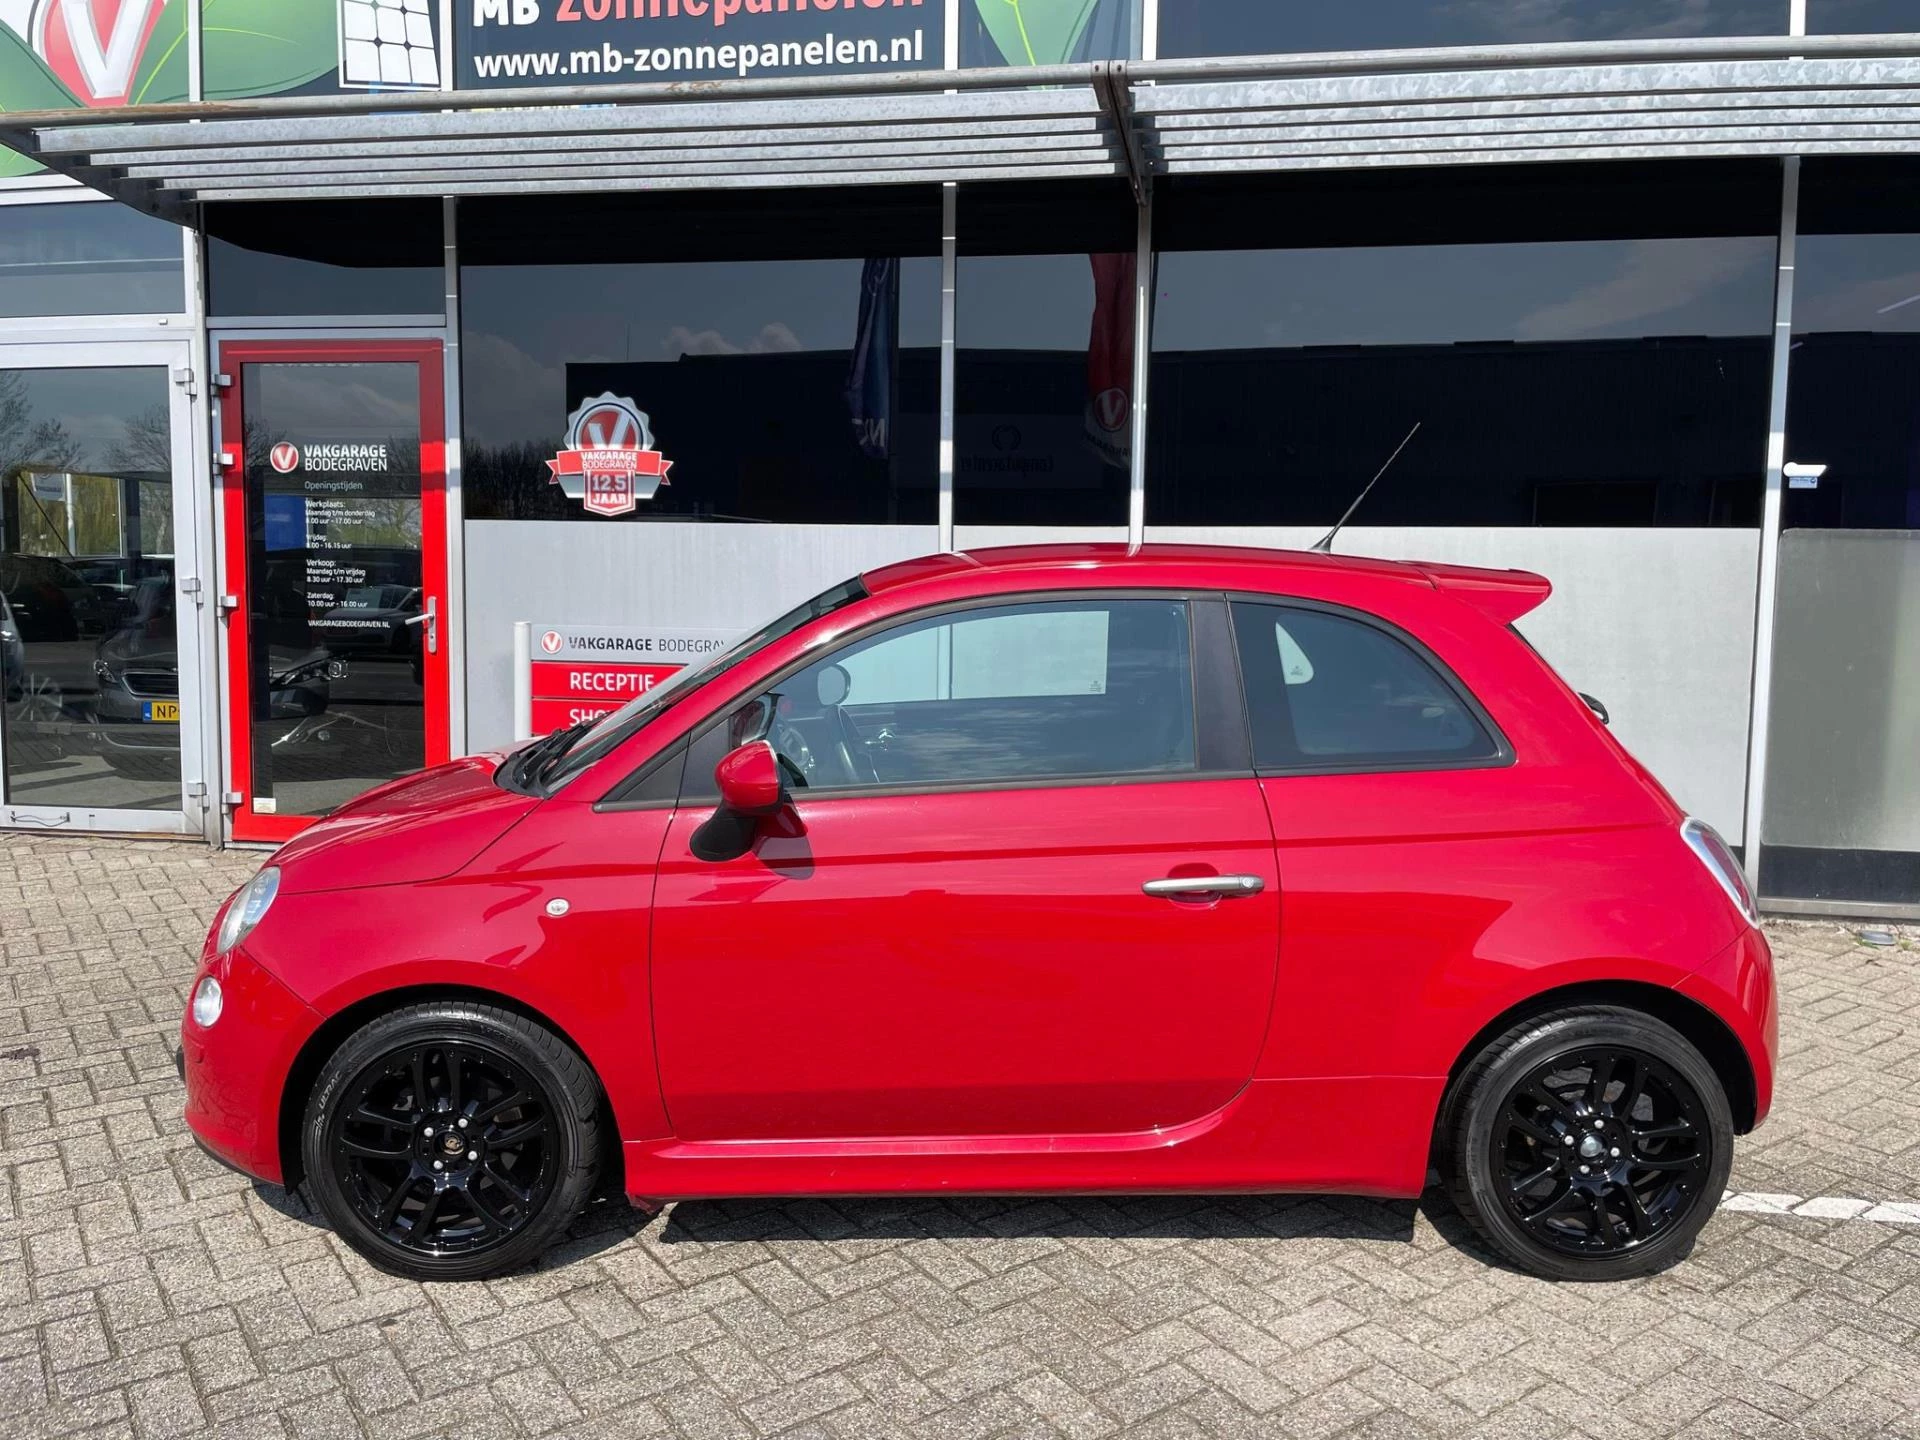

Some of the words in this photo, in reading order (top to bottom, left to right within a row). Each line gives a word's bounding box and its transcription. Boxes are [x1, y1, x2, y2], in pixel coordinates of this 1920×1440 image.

[474, 29, 923, 78] www.mb-zonnepanelen.nl
[304, 444, 388, 458] VAKGARAGE
[580, 452, 638, 461] VAKGARAGE
[304, 458, 388, 472] BODEGRAVEN
[582, 460, 638, 470] BODEGRAVEN
[304, 480, 363, 492] Openingstijden
[592, 474, 627, 492] 12.5
[592, 493, 627, 504] JAAR
[568, 636, 652, 651] VAKGARAGE
[658, 638, 724, 653] BODEGRA
[569, 672, 655, 692] RECEPTIE
[569, 708, 610, 727] SHO
